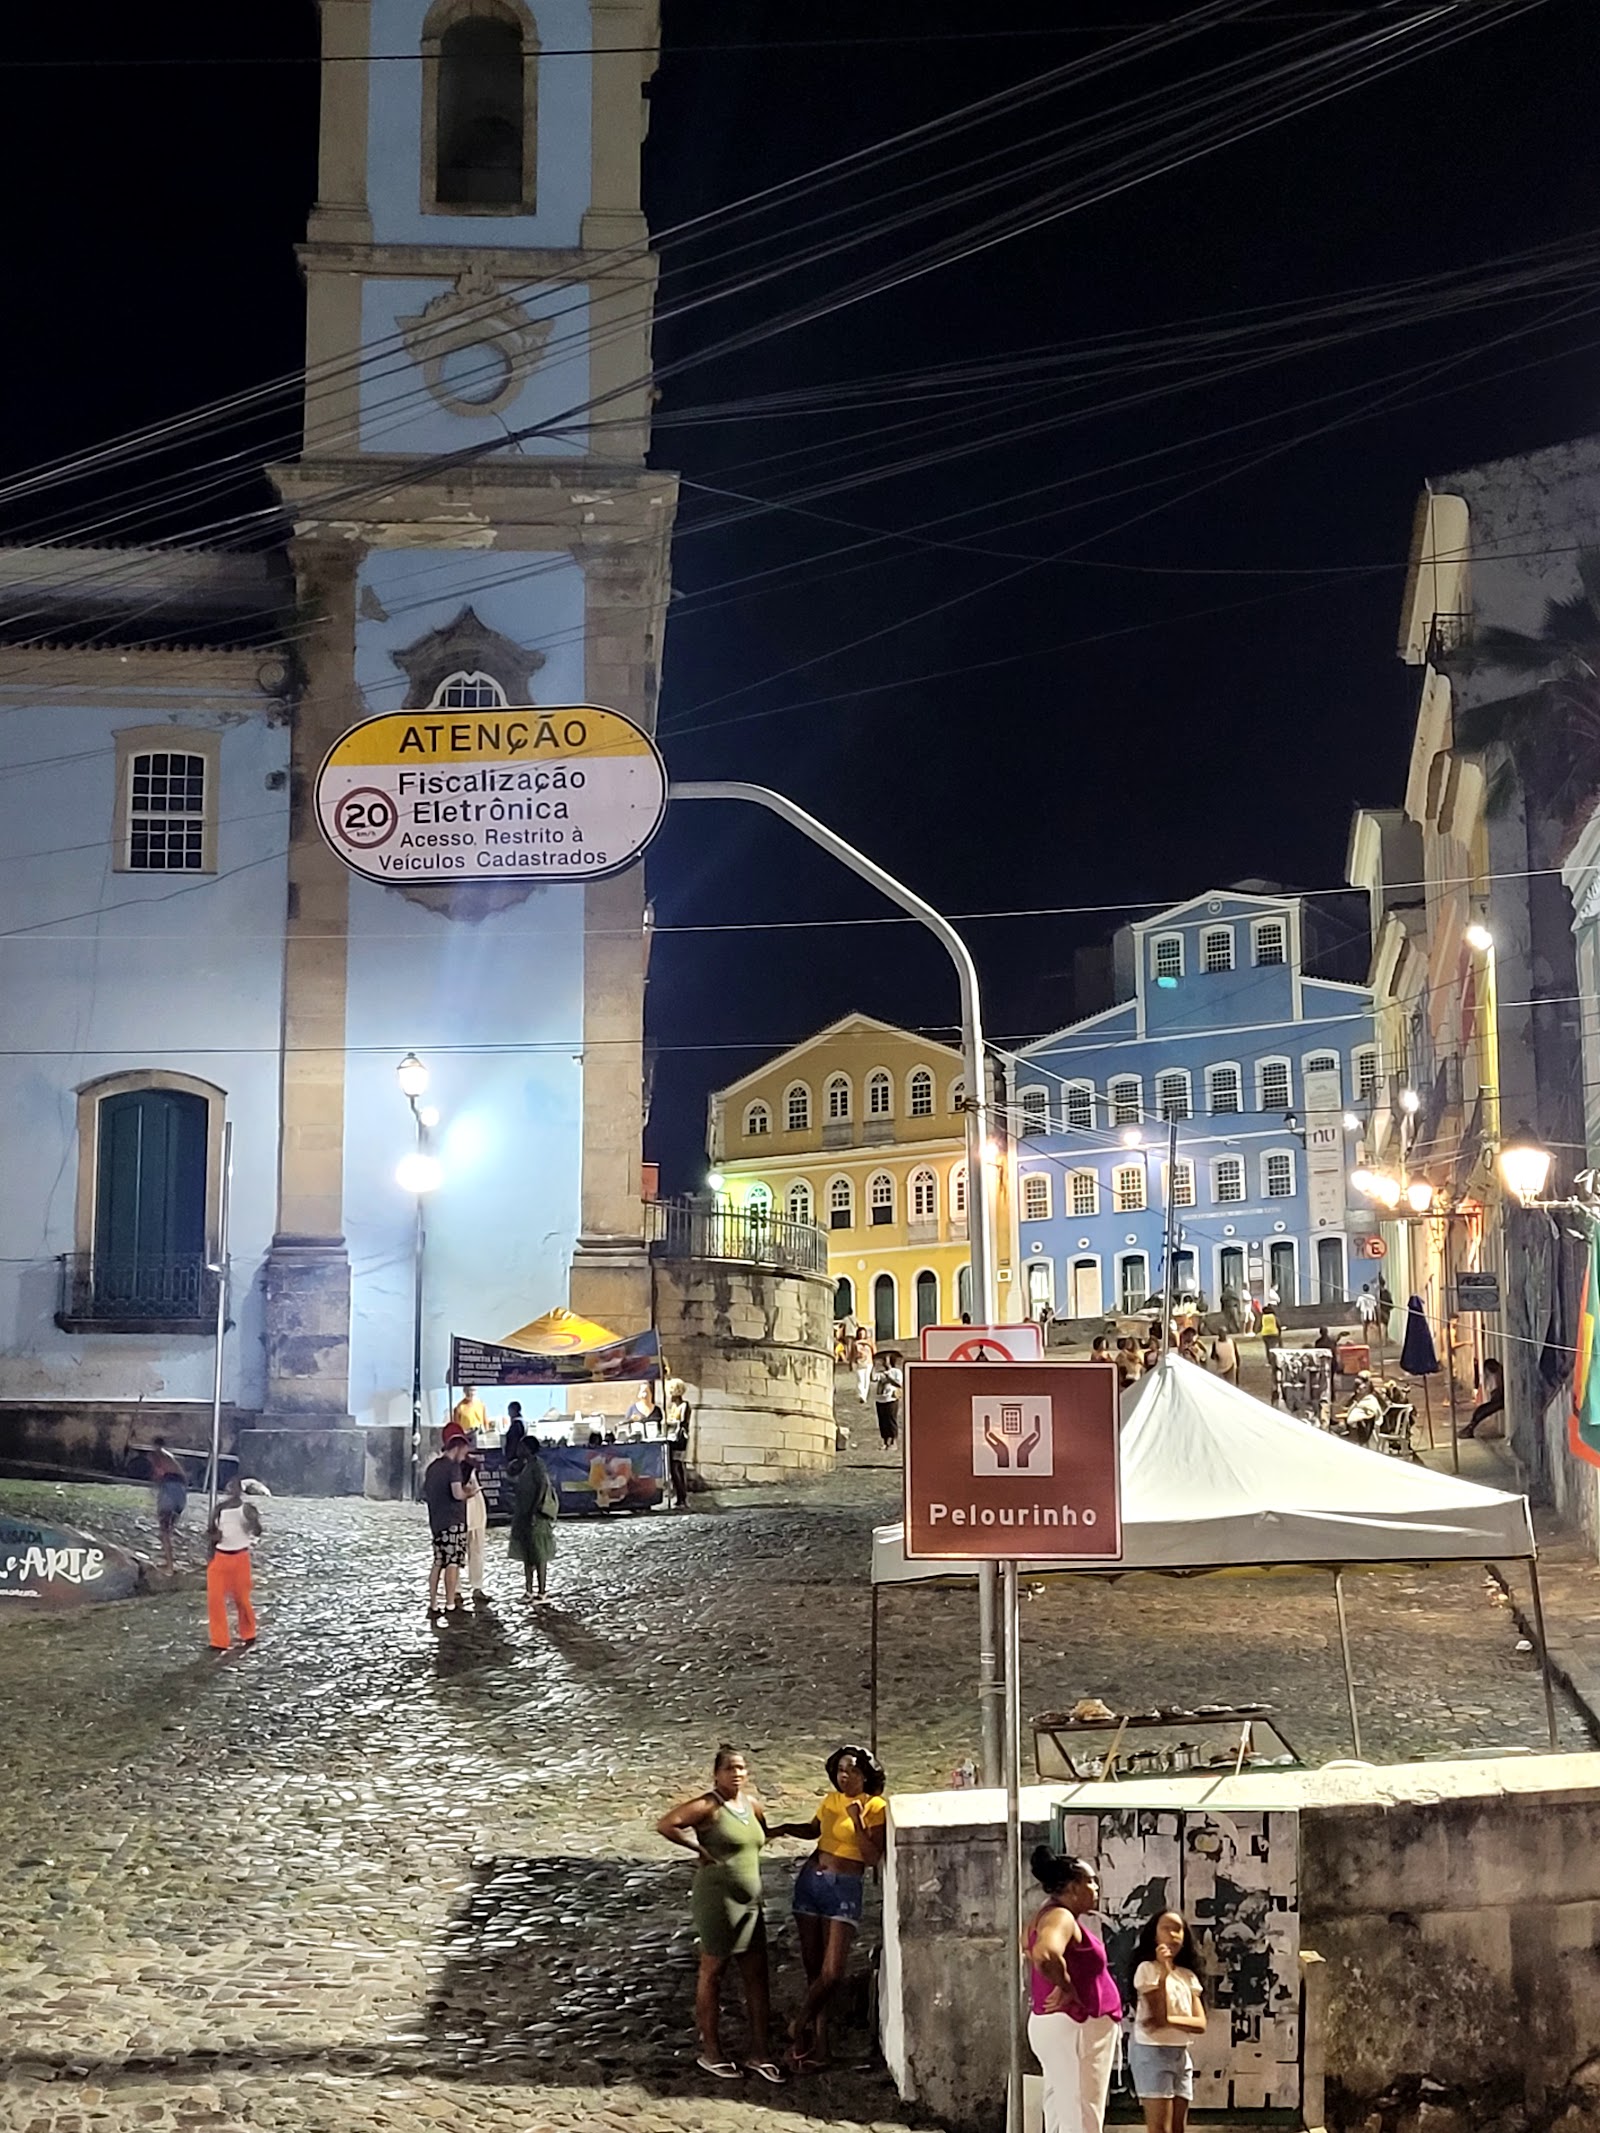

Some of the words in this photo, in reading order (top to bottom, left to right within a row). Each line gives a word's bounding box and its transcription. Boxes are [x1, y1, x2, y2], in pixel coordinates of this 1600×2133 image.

[398, 714, 587, 755] ATENÇÃO
[399, 766, 586, 795] Fiscalização
[345, 803, 388, 828] 20
[413, 797, 569, 824] Eletrônica
[485, 829, 565, 845] Restrito
[571, 826, 583, 843] à
[379, 853, 465, 870] Veículos
[476, 850, 607, 868] Cadastrados
[929, 1503, 1097, 1526] Pelourinho
[19, 1546, 104, 1583] ARTE
